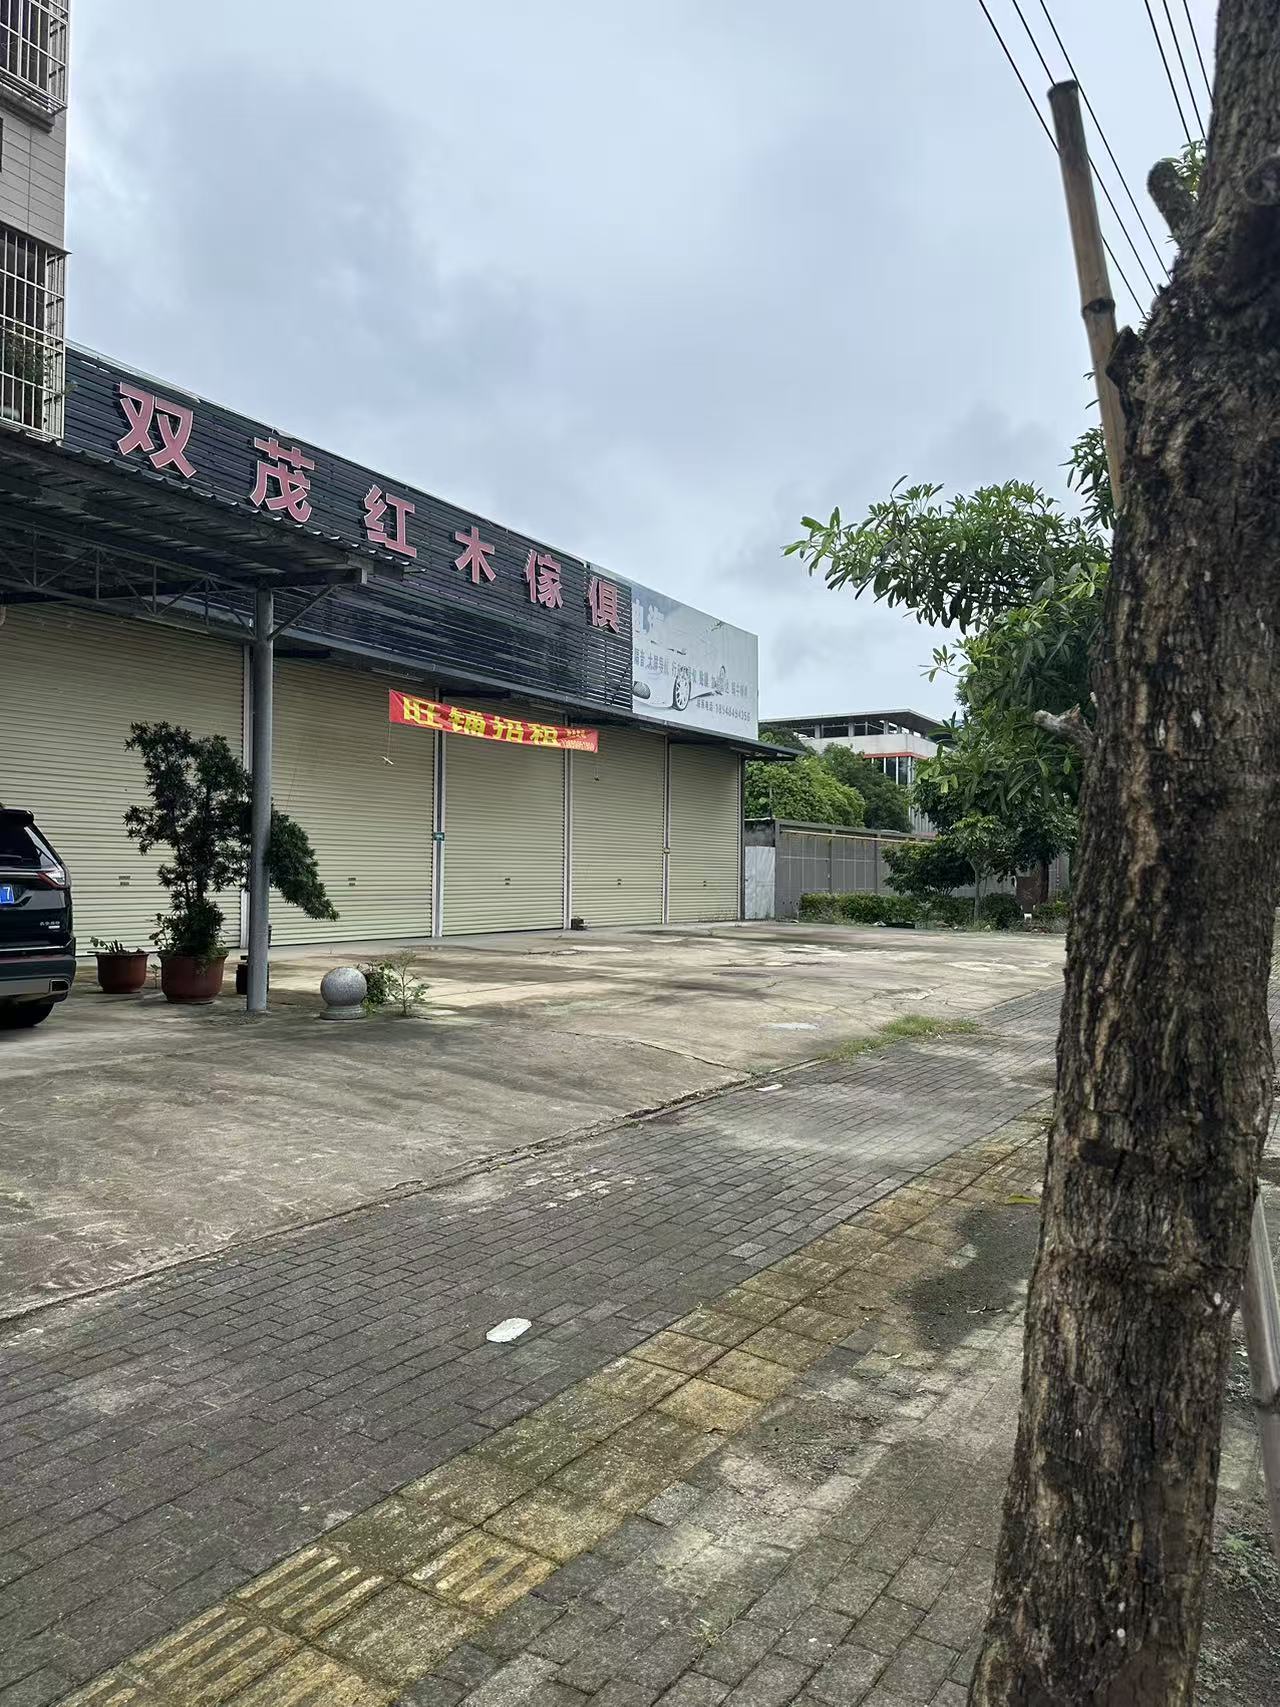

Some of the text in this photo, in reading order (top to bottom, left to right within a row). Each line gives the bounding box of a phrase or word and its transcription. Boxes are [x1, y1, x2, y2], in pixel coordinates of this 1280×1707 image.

[116, 381, 621, 634] 双茂红木傢俱
